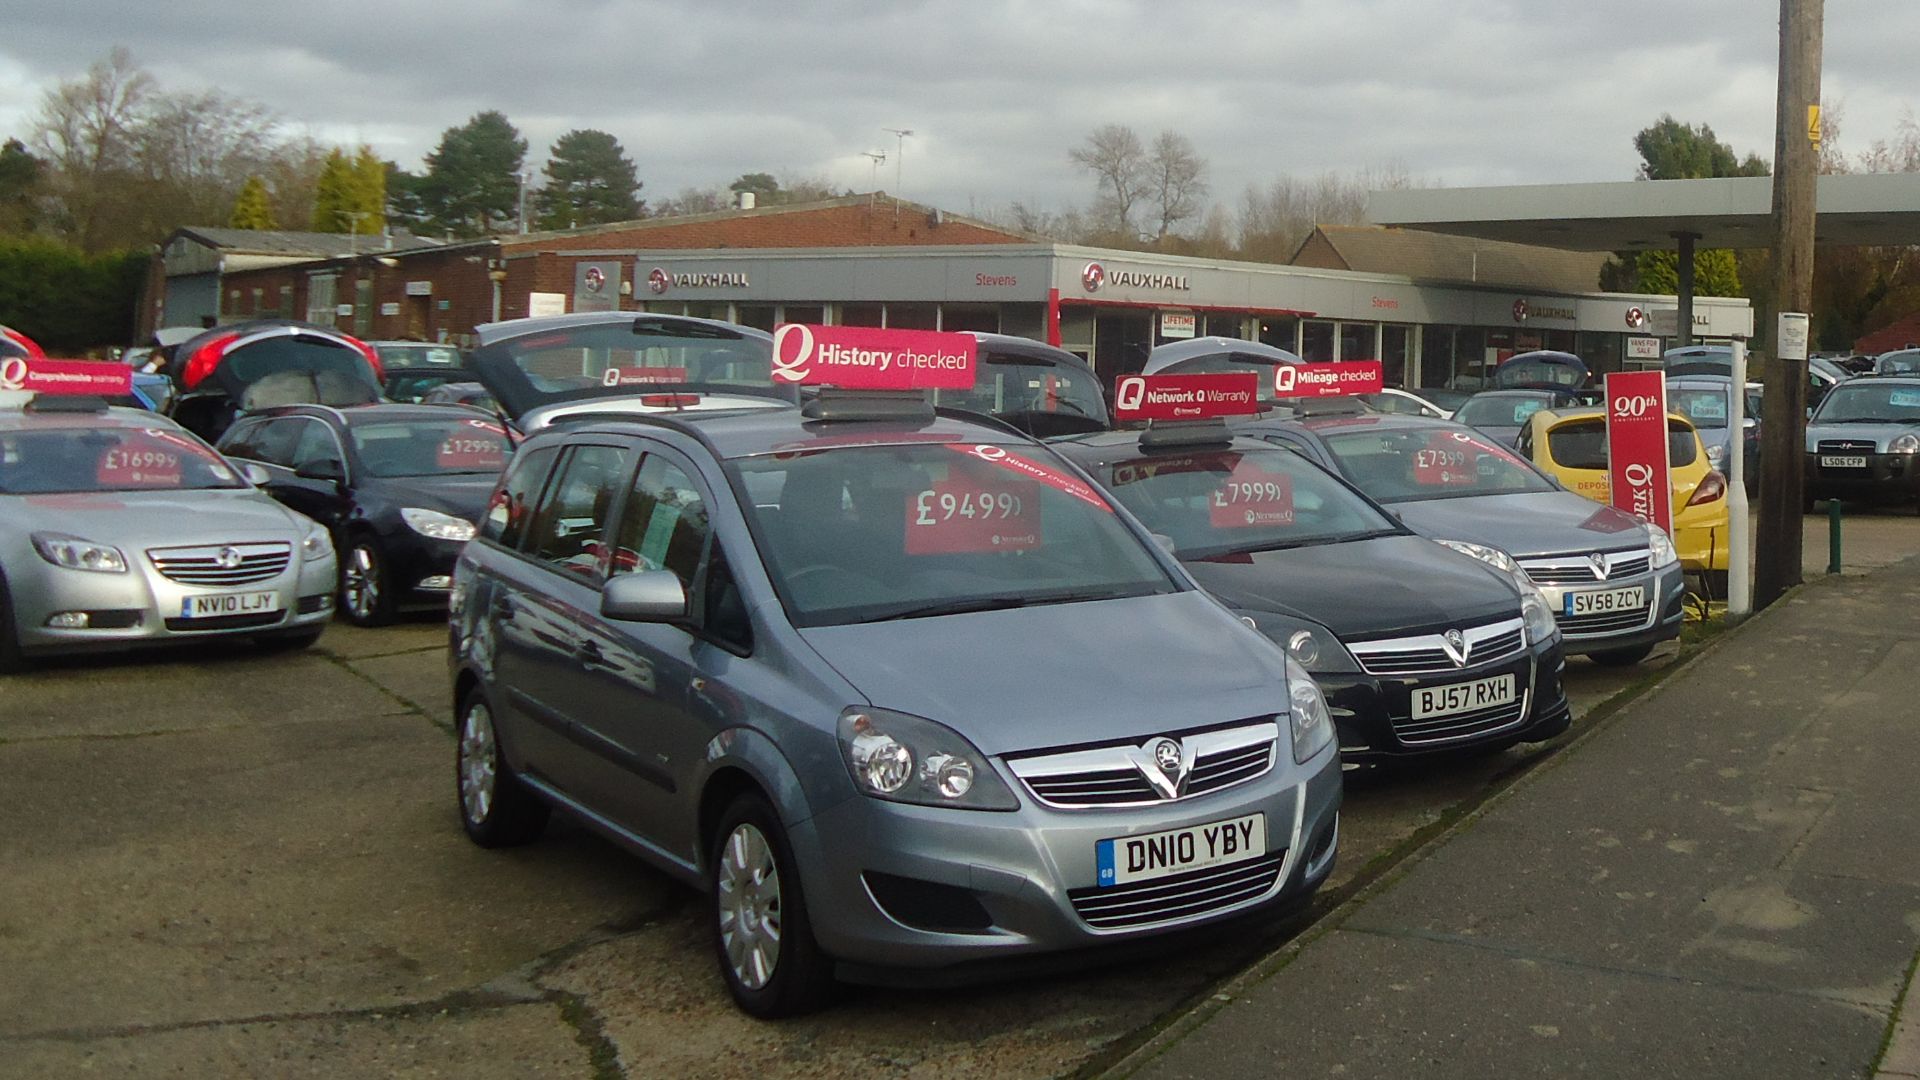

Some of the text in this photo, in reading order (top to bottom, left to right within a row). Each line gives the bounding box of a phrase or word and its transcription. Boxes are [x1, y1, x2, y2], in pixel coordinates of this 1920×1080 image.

[672, 273, 750, 289] VAUXHALL
[975, 272, 1017, 287] Stevens
[1109, 271, 1190, 291] VAUXHALL
[1531, 305, 1576, 320] VAUXHALL
[771, 323, 967, 381] Q History checked
[1, 357, 28, 390] Q
[1277, 366, 1376, 391] Q Mileage checked
[1117, 377, 1251, 411] Q Network Q Warranty
[104, 449, 178, 470] £16999
[197, 594, 272, 613] NV10 LJY
[1575, 591, 1642, 612] SV58 ZCY
[1421, 678, 1508, 714] BJ57 RXH
[1126, 819, 1254, 873] DN10 YBY
